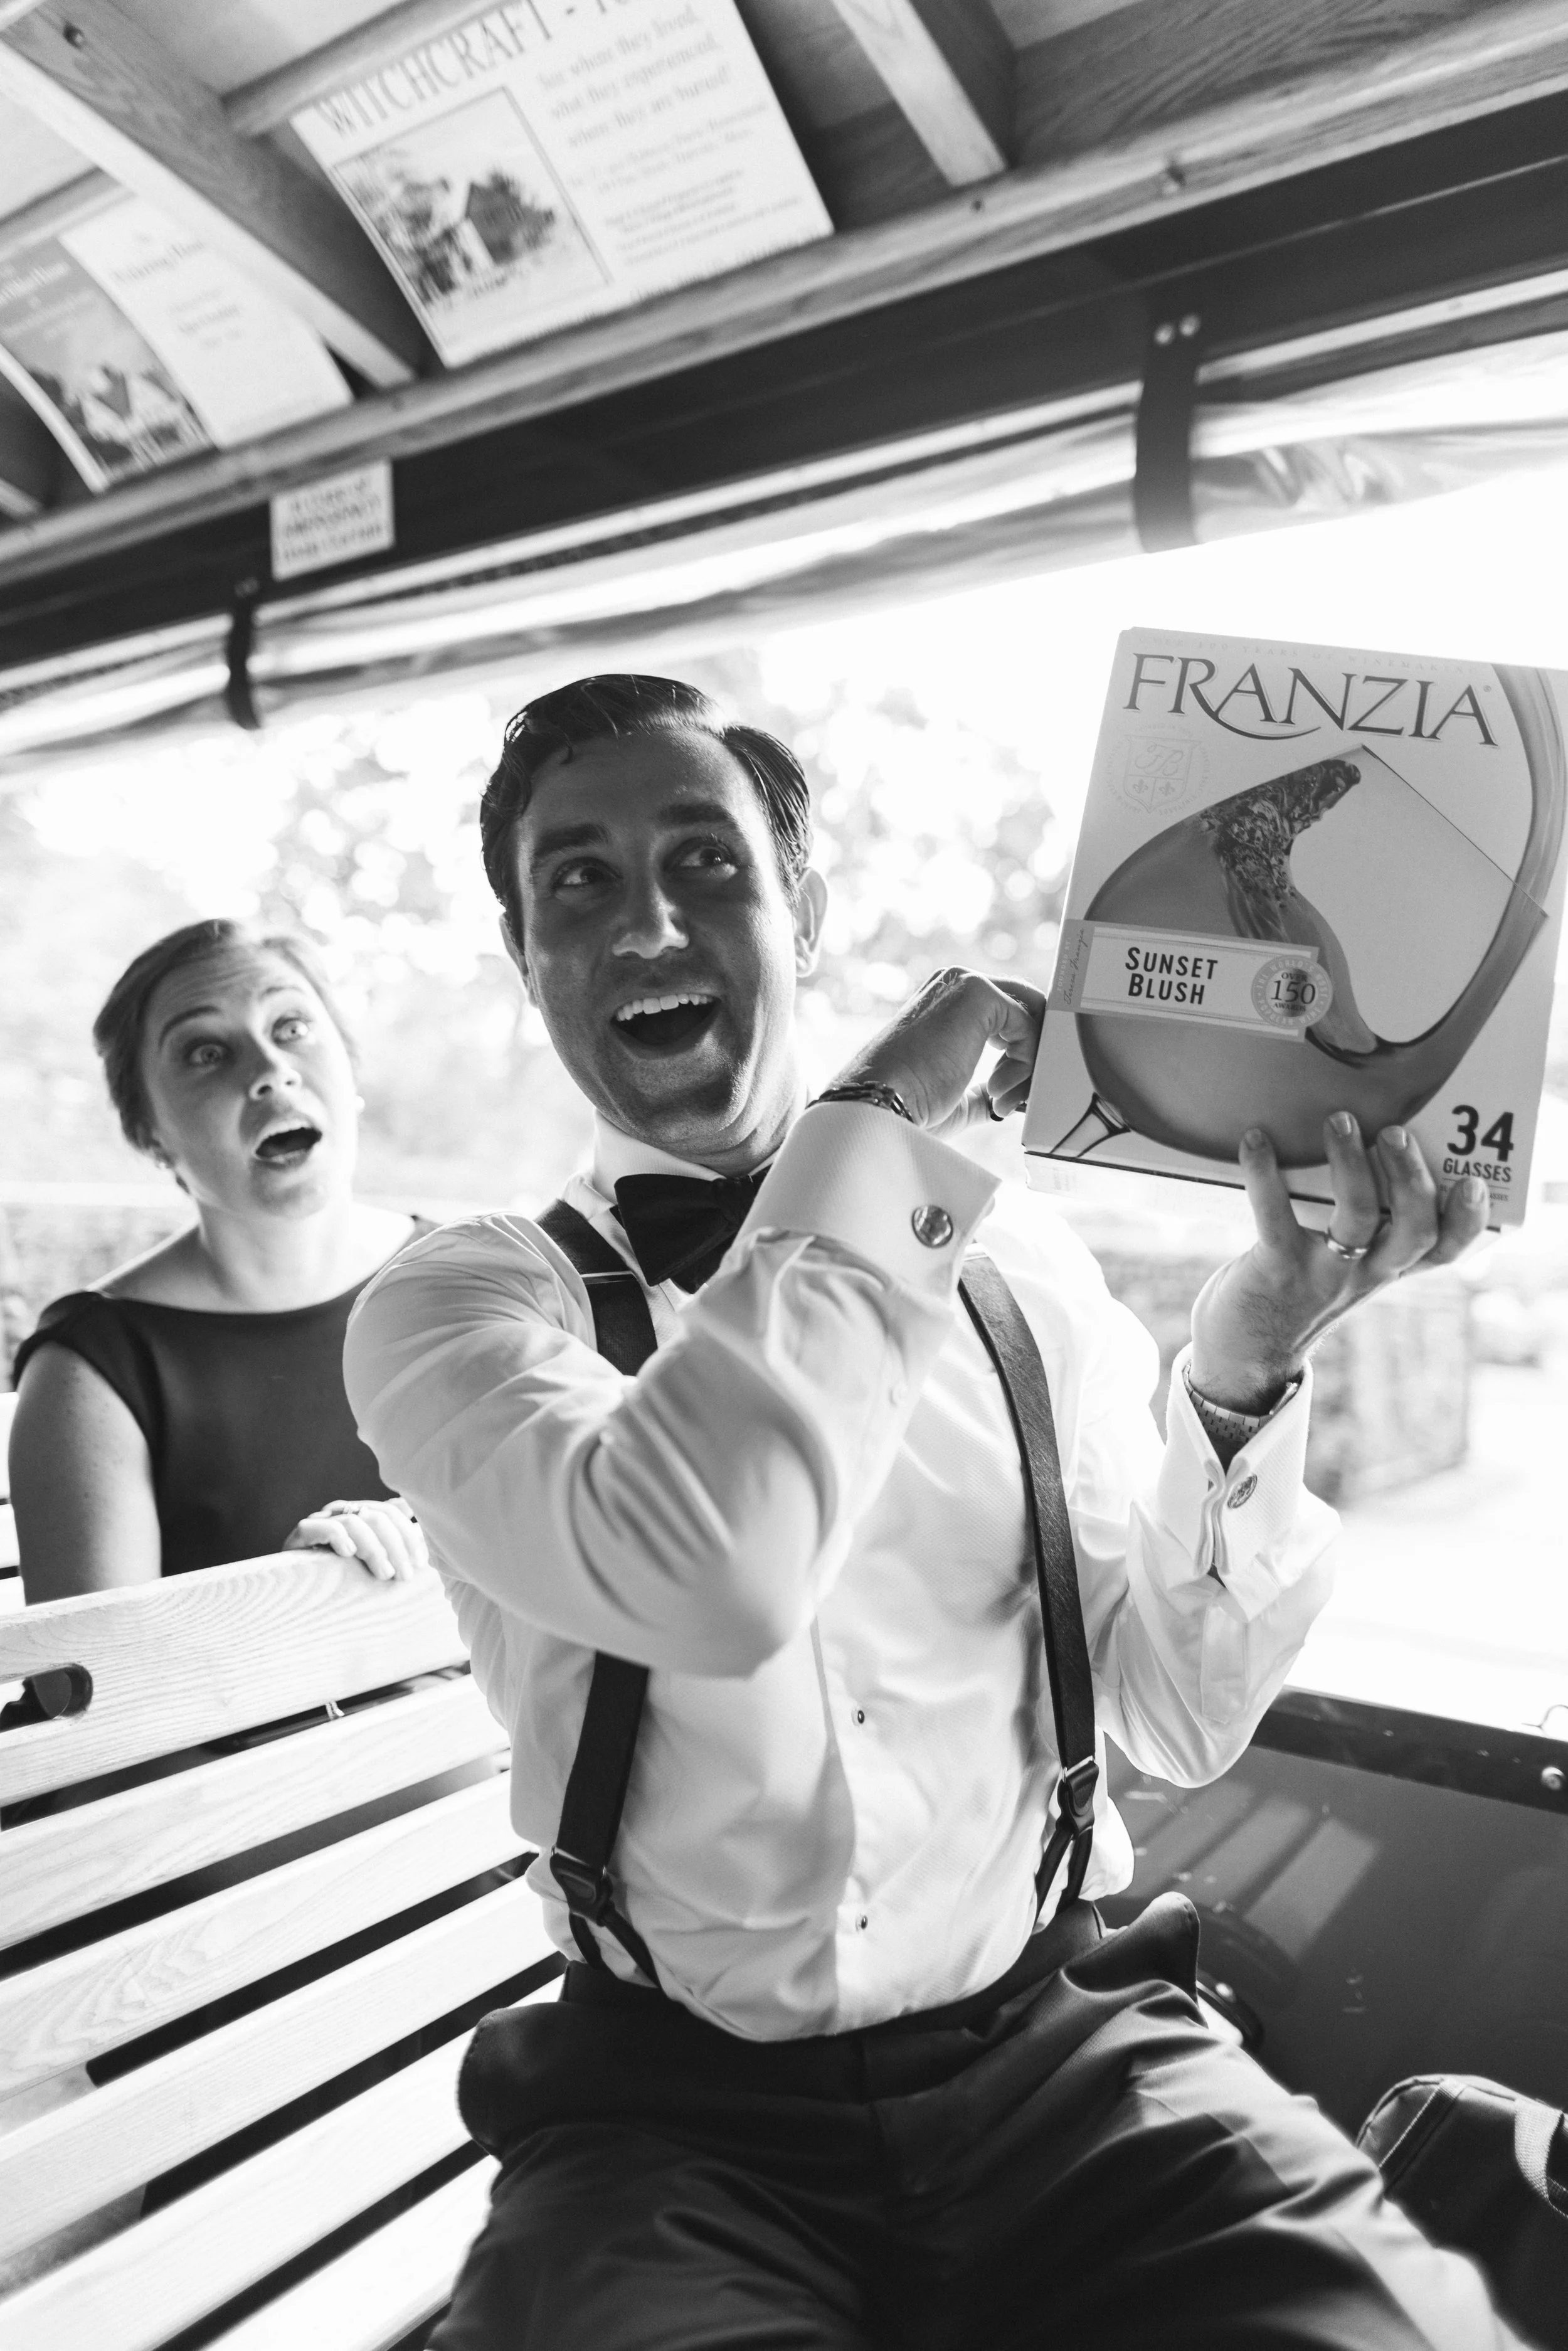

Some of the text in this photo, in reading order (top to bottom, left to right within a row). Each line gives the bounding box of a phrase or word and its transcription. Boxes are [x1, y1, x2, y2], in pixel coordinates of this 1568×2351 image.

[614, 34, 652, 56] they
[315, 0, 553, 137] WITCHCRAFT
[586, 78, 620, 103] they
[614, 103, 647, 129] they
[1242, 645, 1298, 657] YEARS
[1123, 653, 1499, 747] FRANZIA
[1125, 947, 1219, 980] SUNSET
[1128, 973, 1205, 1005] BLUSH
[1281, 972, 1308, 982] OVER
[1271, 980, 1316, 1005] 150
[1447, 1104, 1514, 1162] 34
[1443, 1158, 1512, 1183] GLASSES
